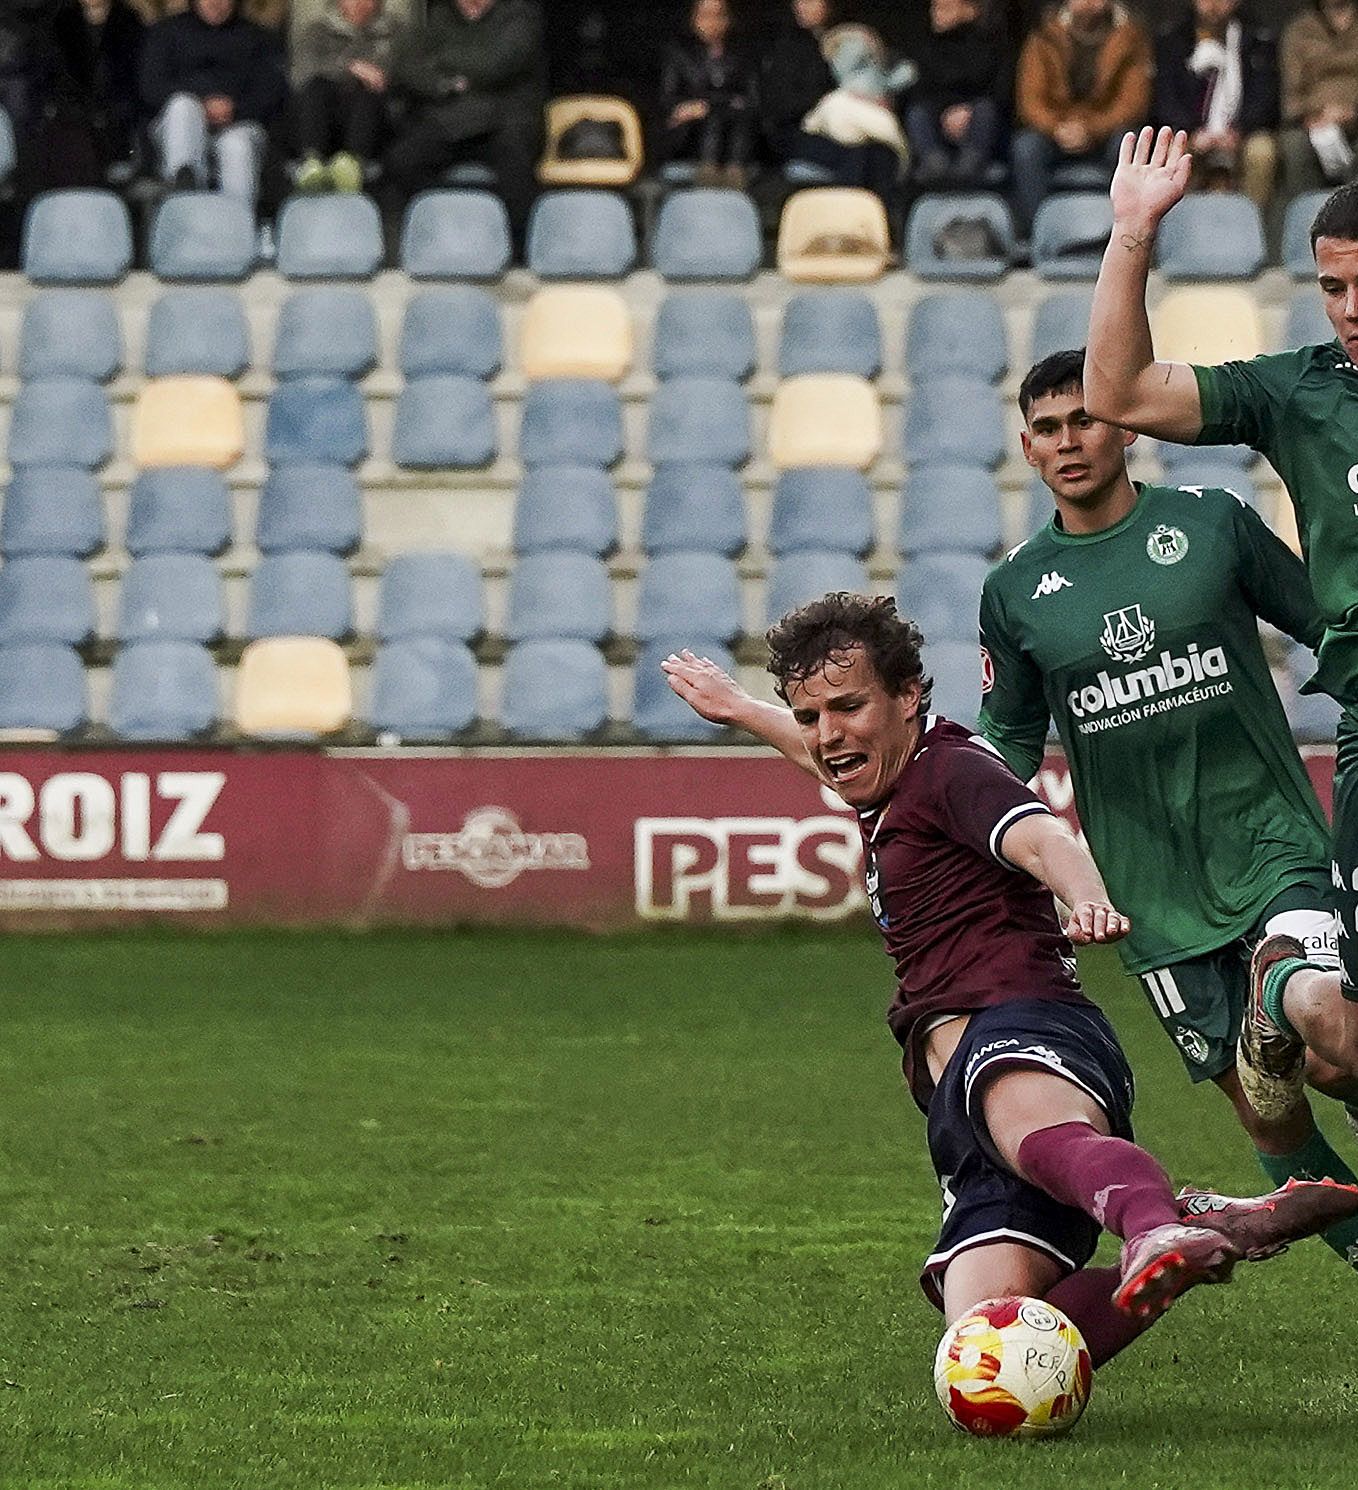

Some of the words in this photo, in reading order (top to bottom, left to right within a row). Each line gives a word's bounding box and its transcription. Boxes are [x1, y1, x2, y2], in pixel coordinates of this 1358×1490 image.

[1067, 643, 1229, 718] columbia
[1143, 681, 1234, 718] FARMACÉUTICA
[638, 820, 860, 916] PES
[1302, 931, 1338, 950] cala
[1141, 967, 1187, 1019] 11
